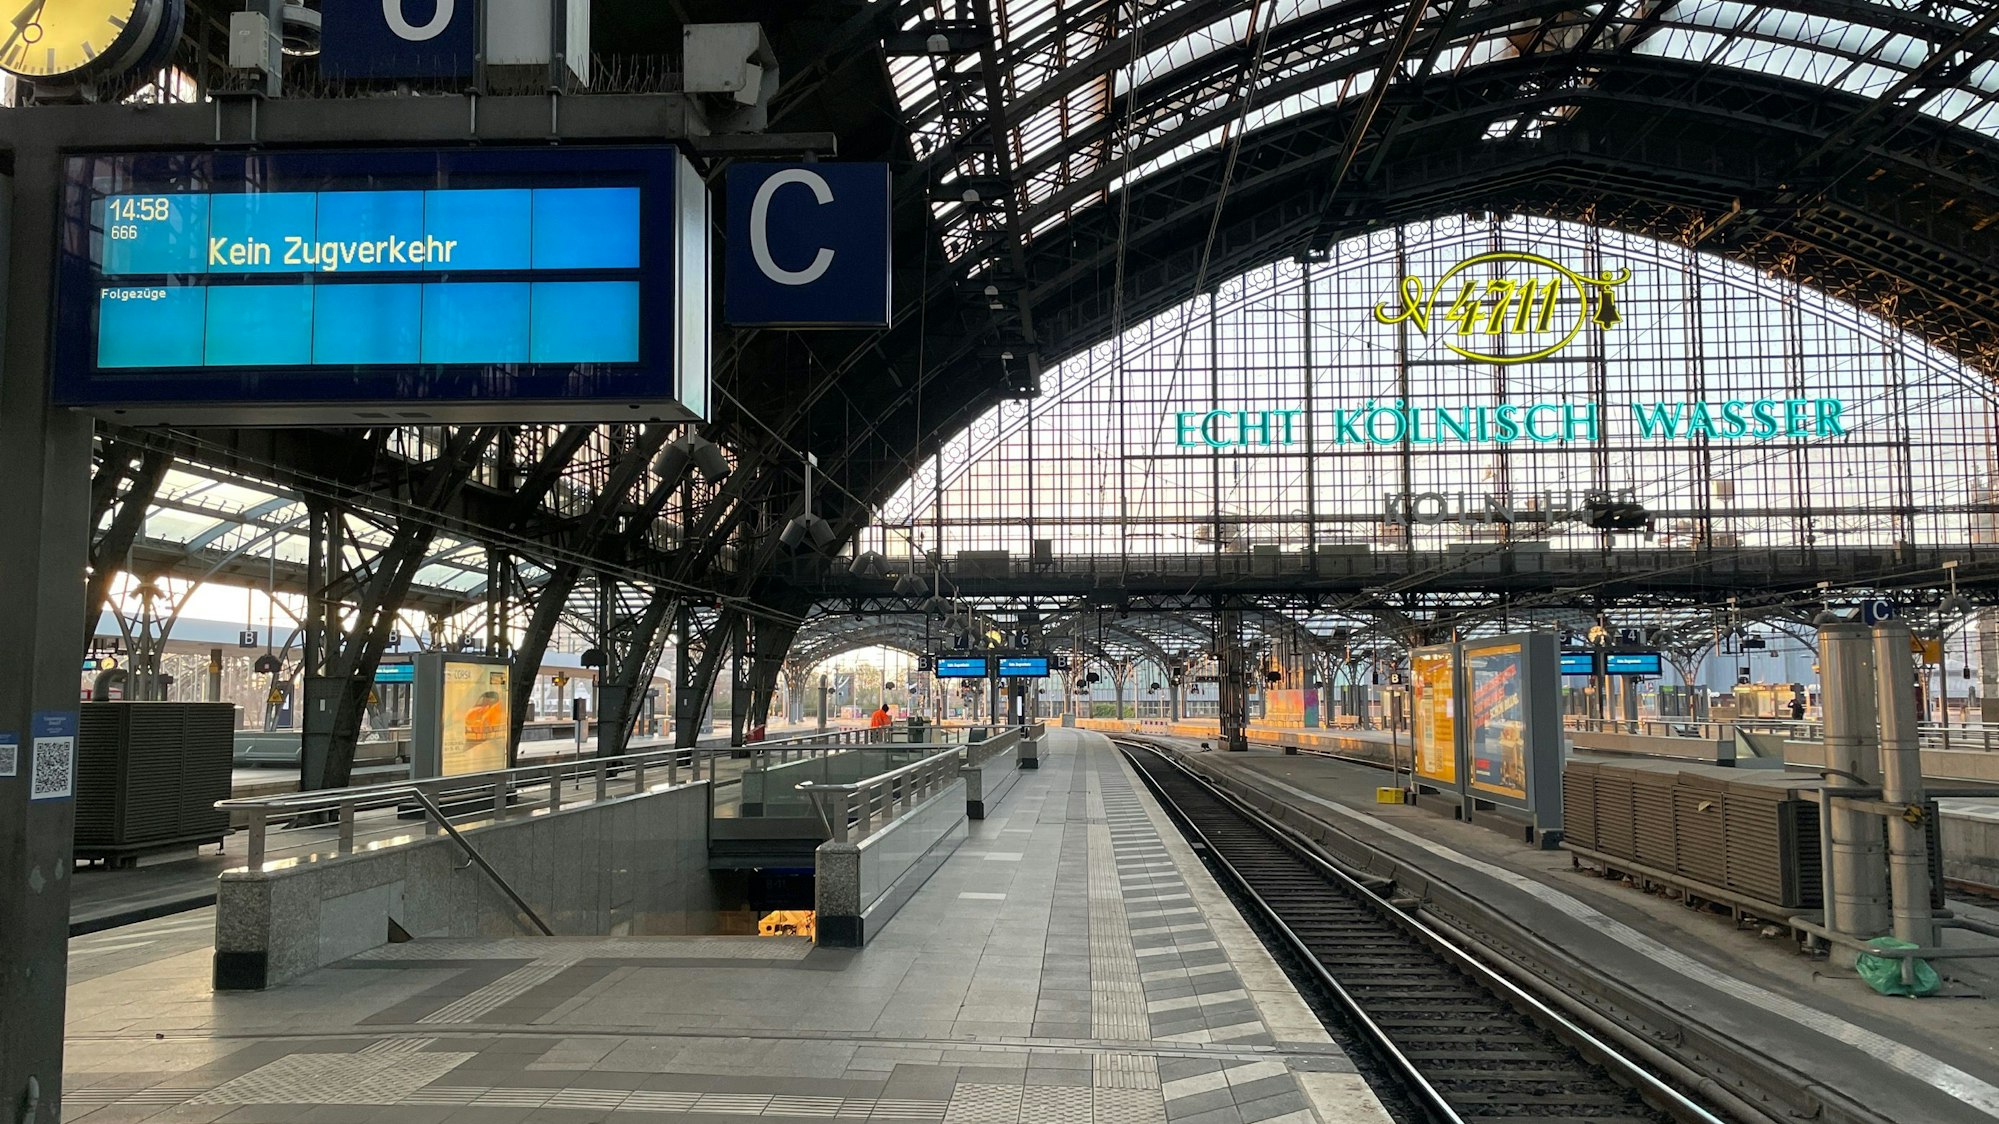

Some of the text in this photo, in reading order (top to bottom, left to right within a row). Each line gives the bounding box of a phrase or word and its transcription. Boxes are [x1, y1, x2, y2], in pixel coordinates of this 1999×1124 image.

[109, 198, 169, 221] 14:58
[111, 225, 138, 239] 666
[750, 168, 835, 286] C
[208, 235, 457, 271] Kein Zugverkehr
[101, 288, 167, 301] Folgezüge
[1444, 277, 1562, 336] 4711
[1174, 398, 1850, 448] ECHT KÖLNISCH WASSER
[1384, 489, 1514, 526] KÖLN
[1872, 601, 1889, 621] C
[244, 632, 254, 645] B
[388, 630, 398, 643] B
[464, 634, 472, 645] 8
[1020, 634, 1029, 646] 6
[1560, 630, 1567, 642] 5
[1628, 630, 1637, 641] 4
[918, 657, 928, 668] B
[1057, 656, 1067, 667] B
[1391, 673, 1399, 683] B
